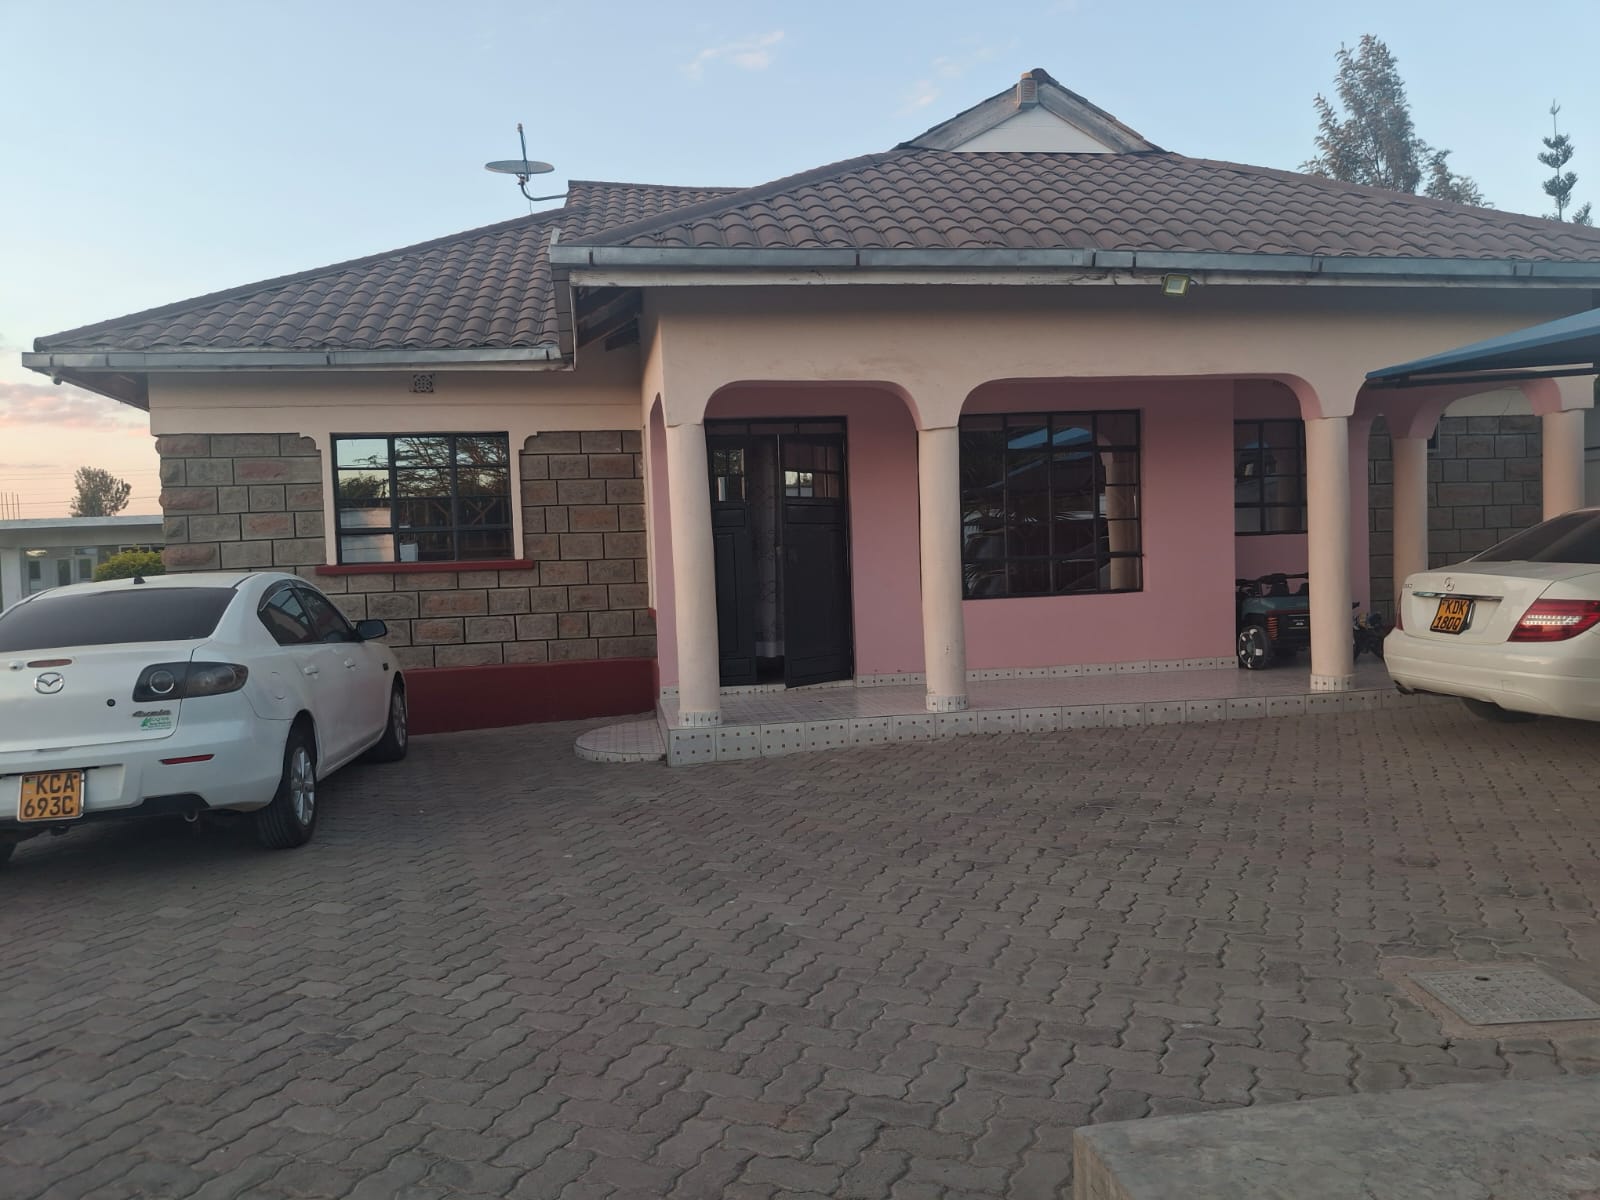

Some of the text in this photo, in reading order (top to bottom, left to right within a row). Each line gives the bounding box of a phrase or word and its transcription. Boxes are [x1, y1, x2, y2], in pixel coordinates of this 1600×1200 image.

[1445, 600, 1468, 615] KDK
[36, 774, 75, 795] KCA
[24, 795, 74, 817] 693C
